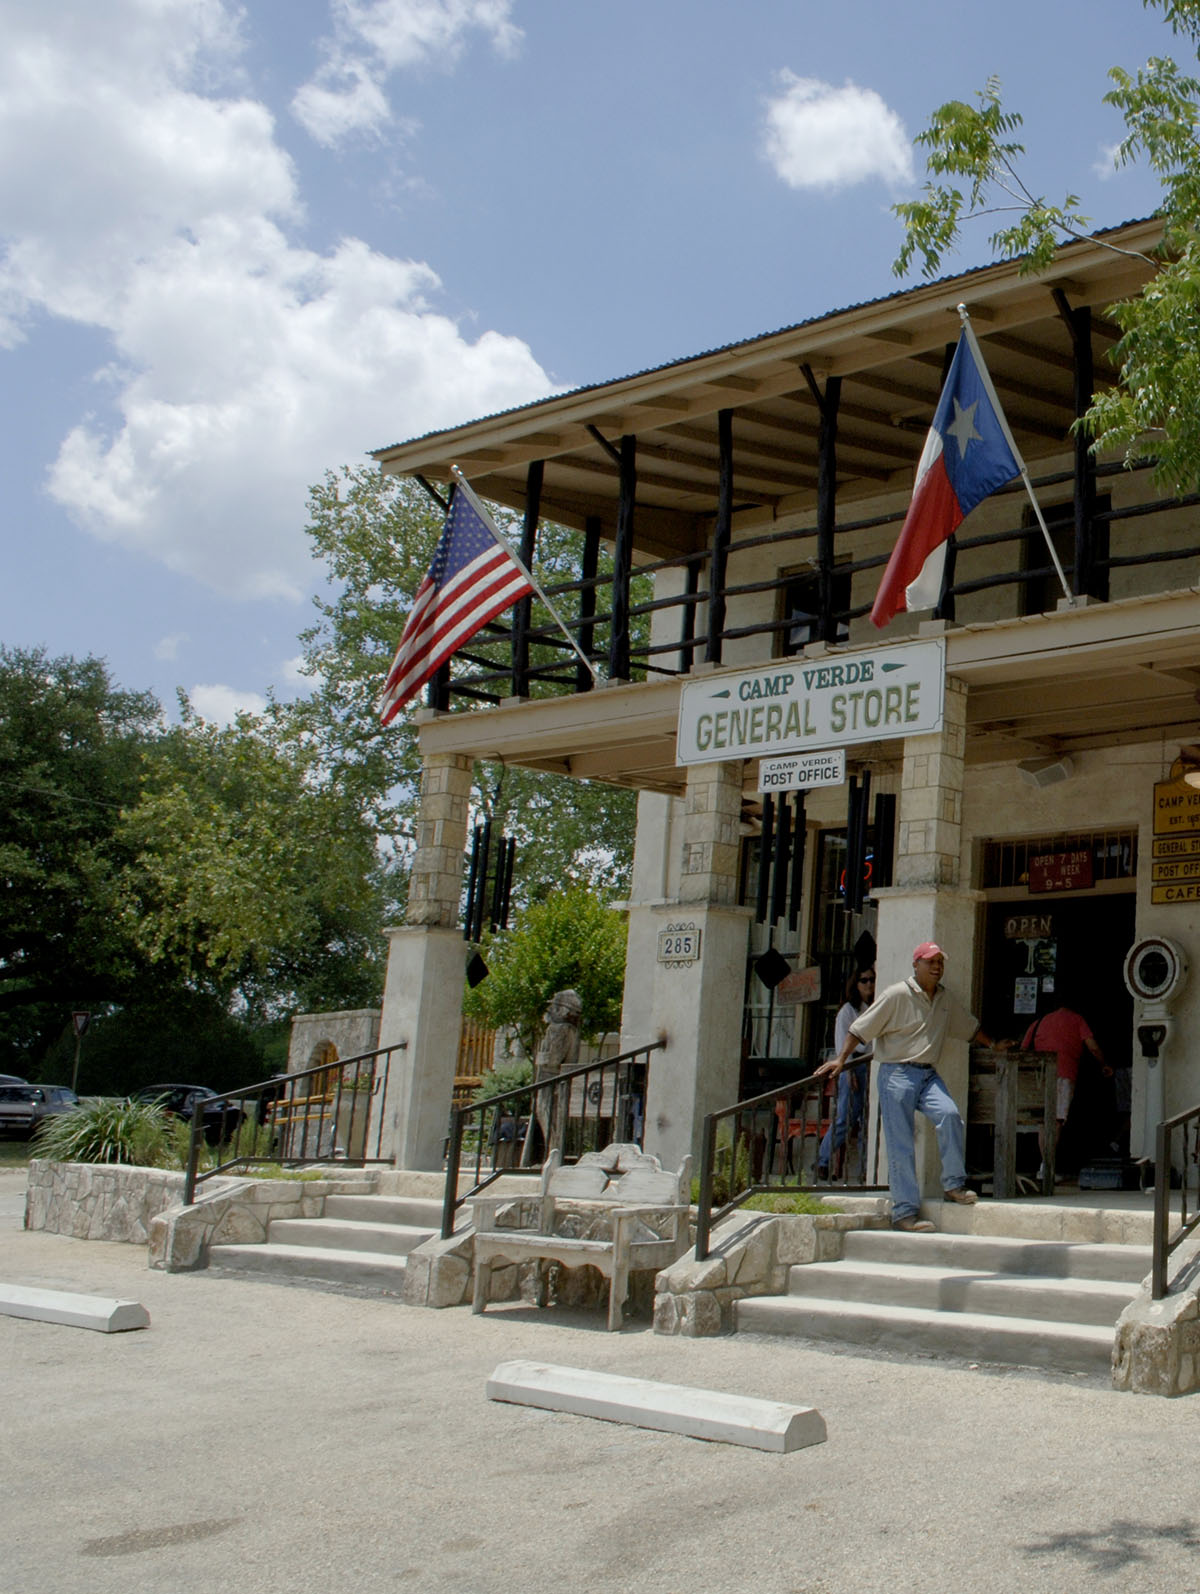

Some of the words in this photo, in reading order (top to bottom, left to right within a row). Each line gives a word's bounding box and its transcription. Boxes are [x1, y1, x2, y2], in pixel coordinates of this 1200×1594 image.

[739, 674, 795, 701] CAMP
[803, 660, 874, 691] VERDE
[696, 698, 817, 752] GENERAL
[830, 681, 921, 733] STORE
[769, 762, 798, 771] CAMP
[802, 757, 834, 767] VERDE
[763, 772, 794, 786] POST
[799, 767, 839, 782] OFFICE
[1159, 797, 1184, 808] CAMP
[1158, 842, 1187, 854] GENERAL
[1034, 855, 1054, 866] OPEN
[1058, 853, 1066, 865] 7
[1071, 851, 1087, 864] DAYS
[1159, 864, 1180, 877] POST
[1007, 915, 1052, 935] OPEN
[665, 938, 691, 954] 285
